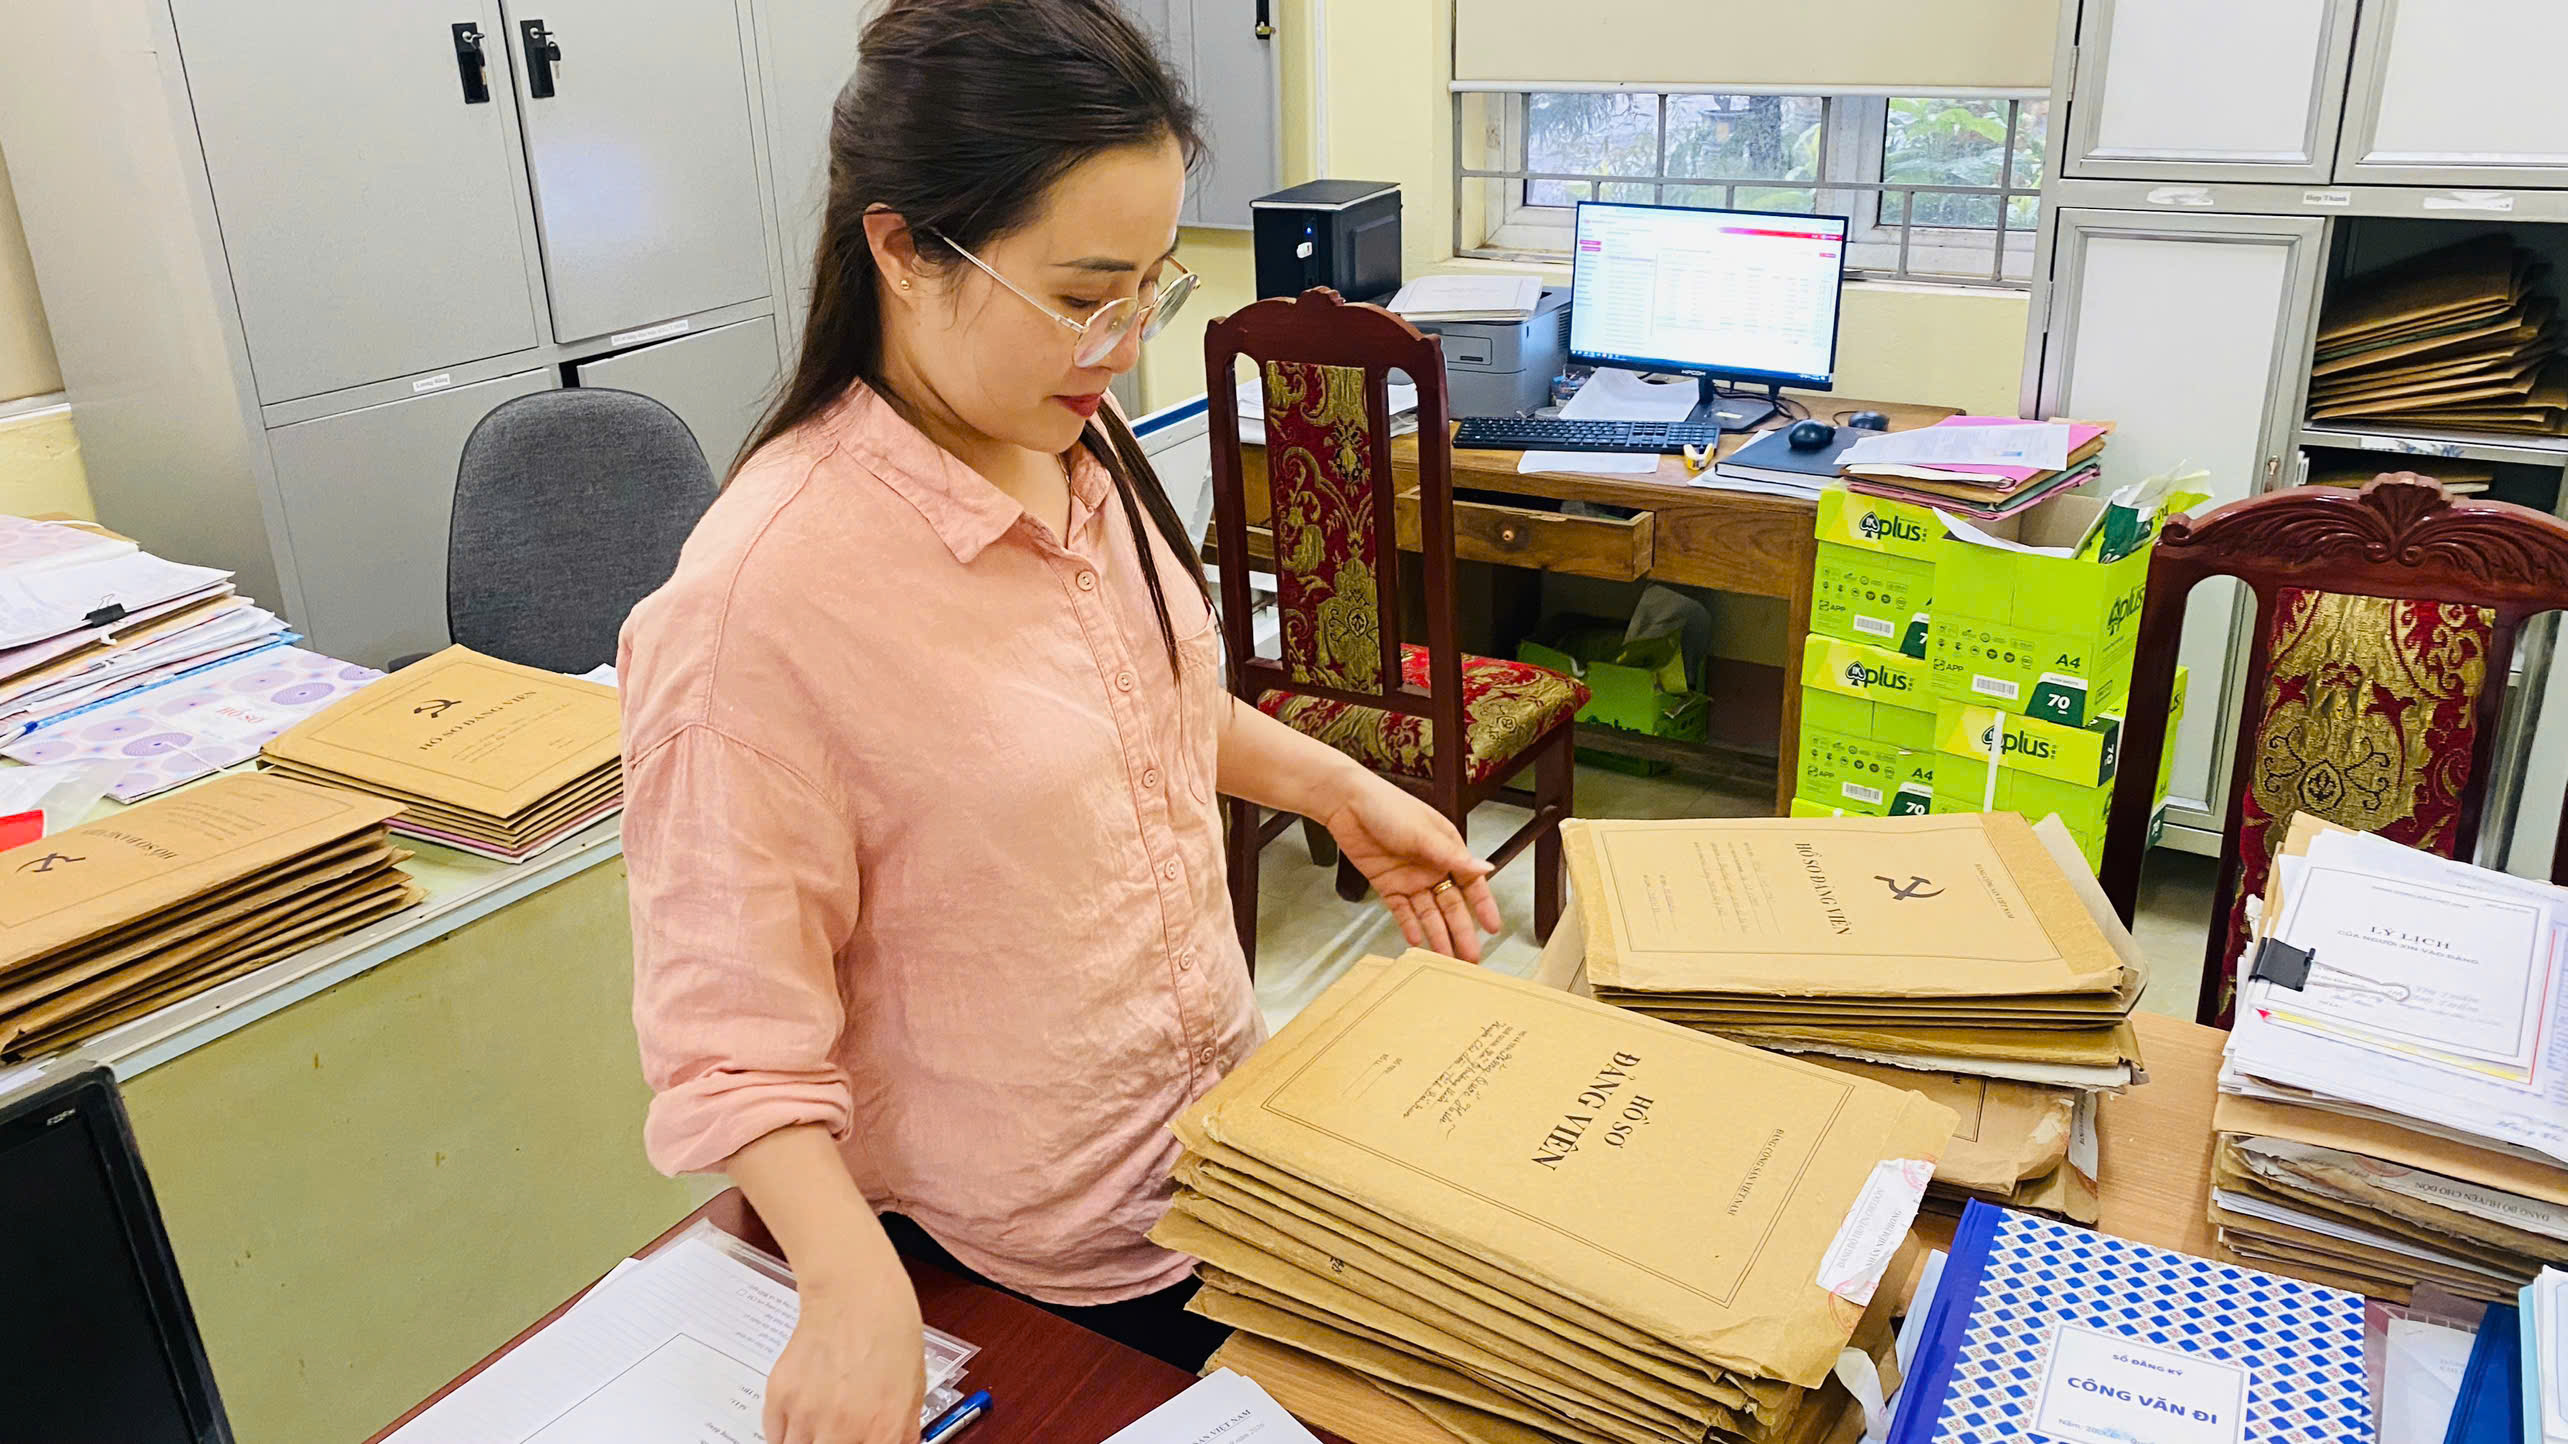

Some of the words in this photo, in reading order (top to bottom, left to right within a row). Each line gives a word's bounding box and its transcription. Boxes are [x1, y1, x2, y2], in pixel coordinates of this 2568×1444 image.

[2056, 654, 2081, 668] A4
[2047, 693, 2071, 709] 70
[1912, 768, 1934, 781] A4
[1906, 802, 1925, 816] 70
[1827, 908, 1853, 935] VIÊN
[1577, 1051, 1641, 1110] ĐẢNG
[1623, 1095, 1655, 1125] HỒ
[1531, 1115, 1593, 1171] VIÊN
[1604, 1121, 1633, 1149] SƠ
[2067, 1377, 2132, 1402] CÔNG
[2138, 1395, 2186, 1416] VĂN
[2192, 1410, 2217, 1425] ĐI
[1230, 1409, 1251, 1421] NAM
